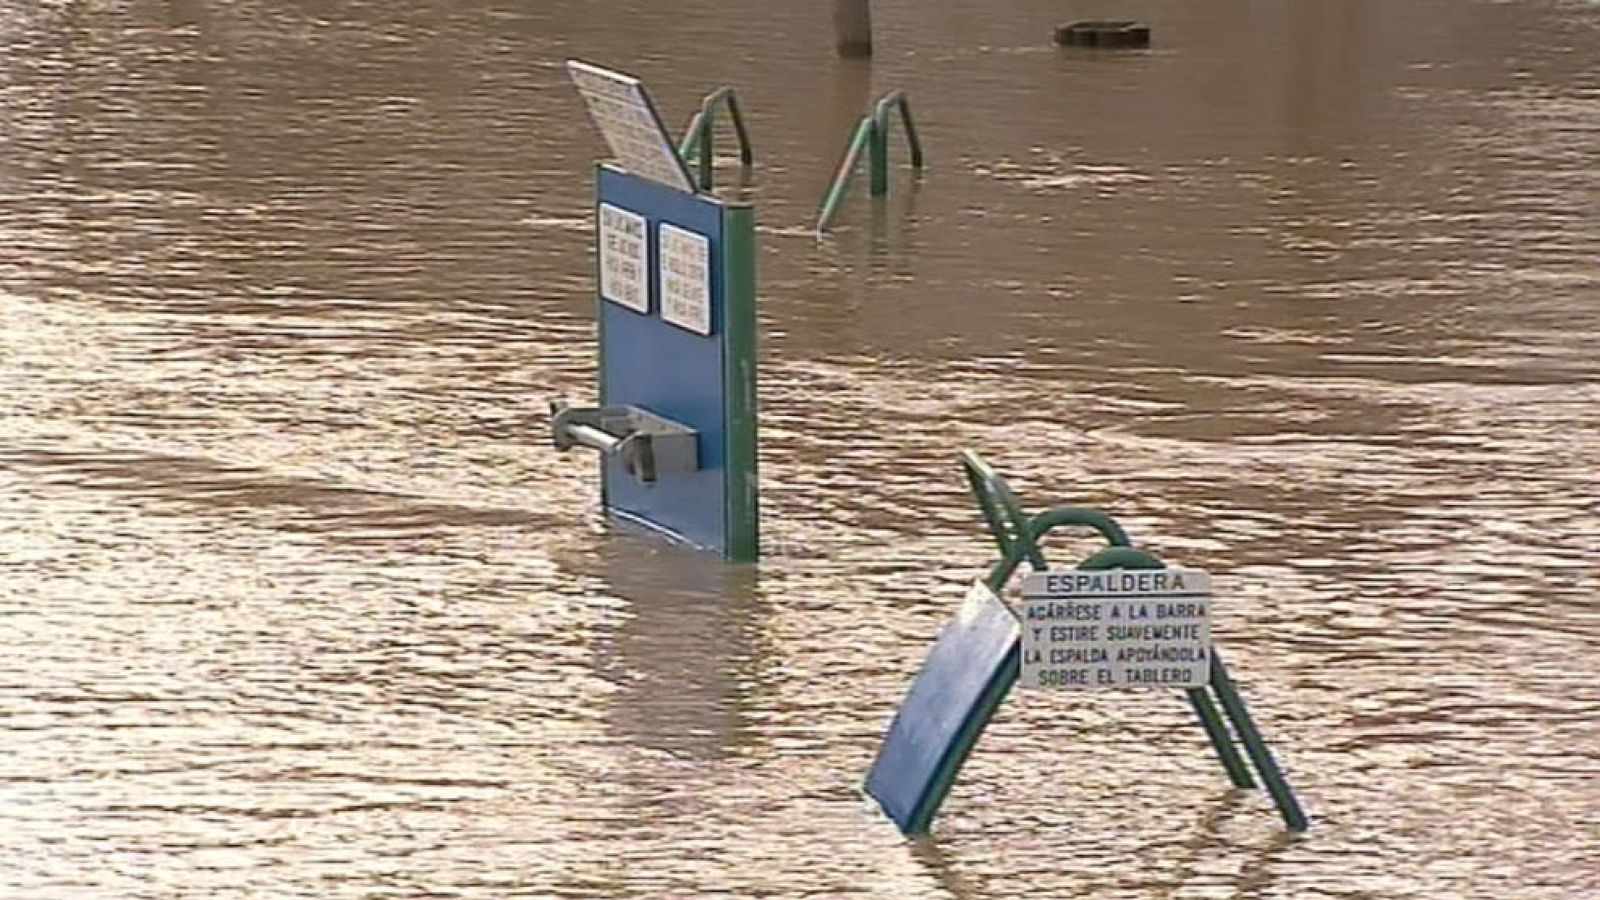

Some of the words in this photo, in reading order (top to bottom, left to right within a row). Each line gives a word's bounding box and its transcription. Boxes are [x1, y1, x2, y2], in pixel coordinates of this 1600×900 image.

[1046, 574, 1185, 593] ESPALDERA
[1111, 605, 1121, 619] A
[1129, 604, 1148, 619] LA
[1156, 603, 1206, 618] BARRA
[1032, 627, 1042, 641] Y
[1050, 626, 1100, 641] ESTIRE
[1106, 625, 1200, 641] SUAVEMENTE
[1024, 649, 1042, 663] LA
[1050, 649, 1108, 663] ESPALDA
[1038, 669, 1089, 685] SOBRE
[1097, 669, 1115, 684] EL
[1126, 668, 1192, 683] TABLERO
